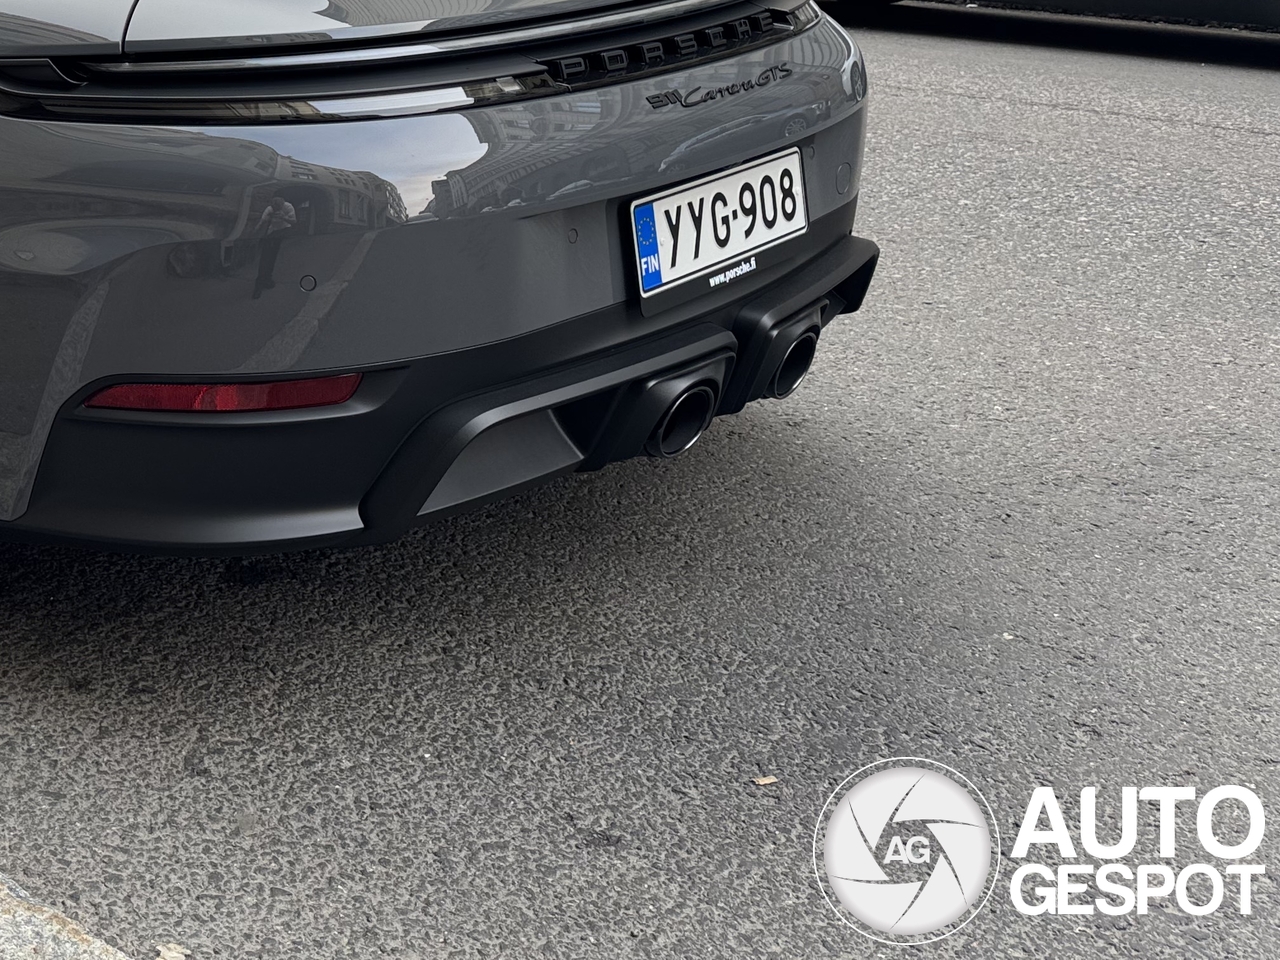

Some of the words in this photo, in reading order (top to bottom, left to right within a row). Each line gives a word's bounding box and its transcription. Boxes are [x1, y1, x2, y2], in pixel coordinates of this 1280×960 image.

[558, 12, 774, 81] PORSCHE
[646, 89, 683, 109] 911
[681, 79, 755, 108] Carrera
[755, 62, 793, 87] GTS
[664, 168, 797, 270] YYG-908
[641, 253, 660, 276] FIN
[709, 257, 756, 287] www.porsche.fi
